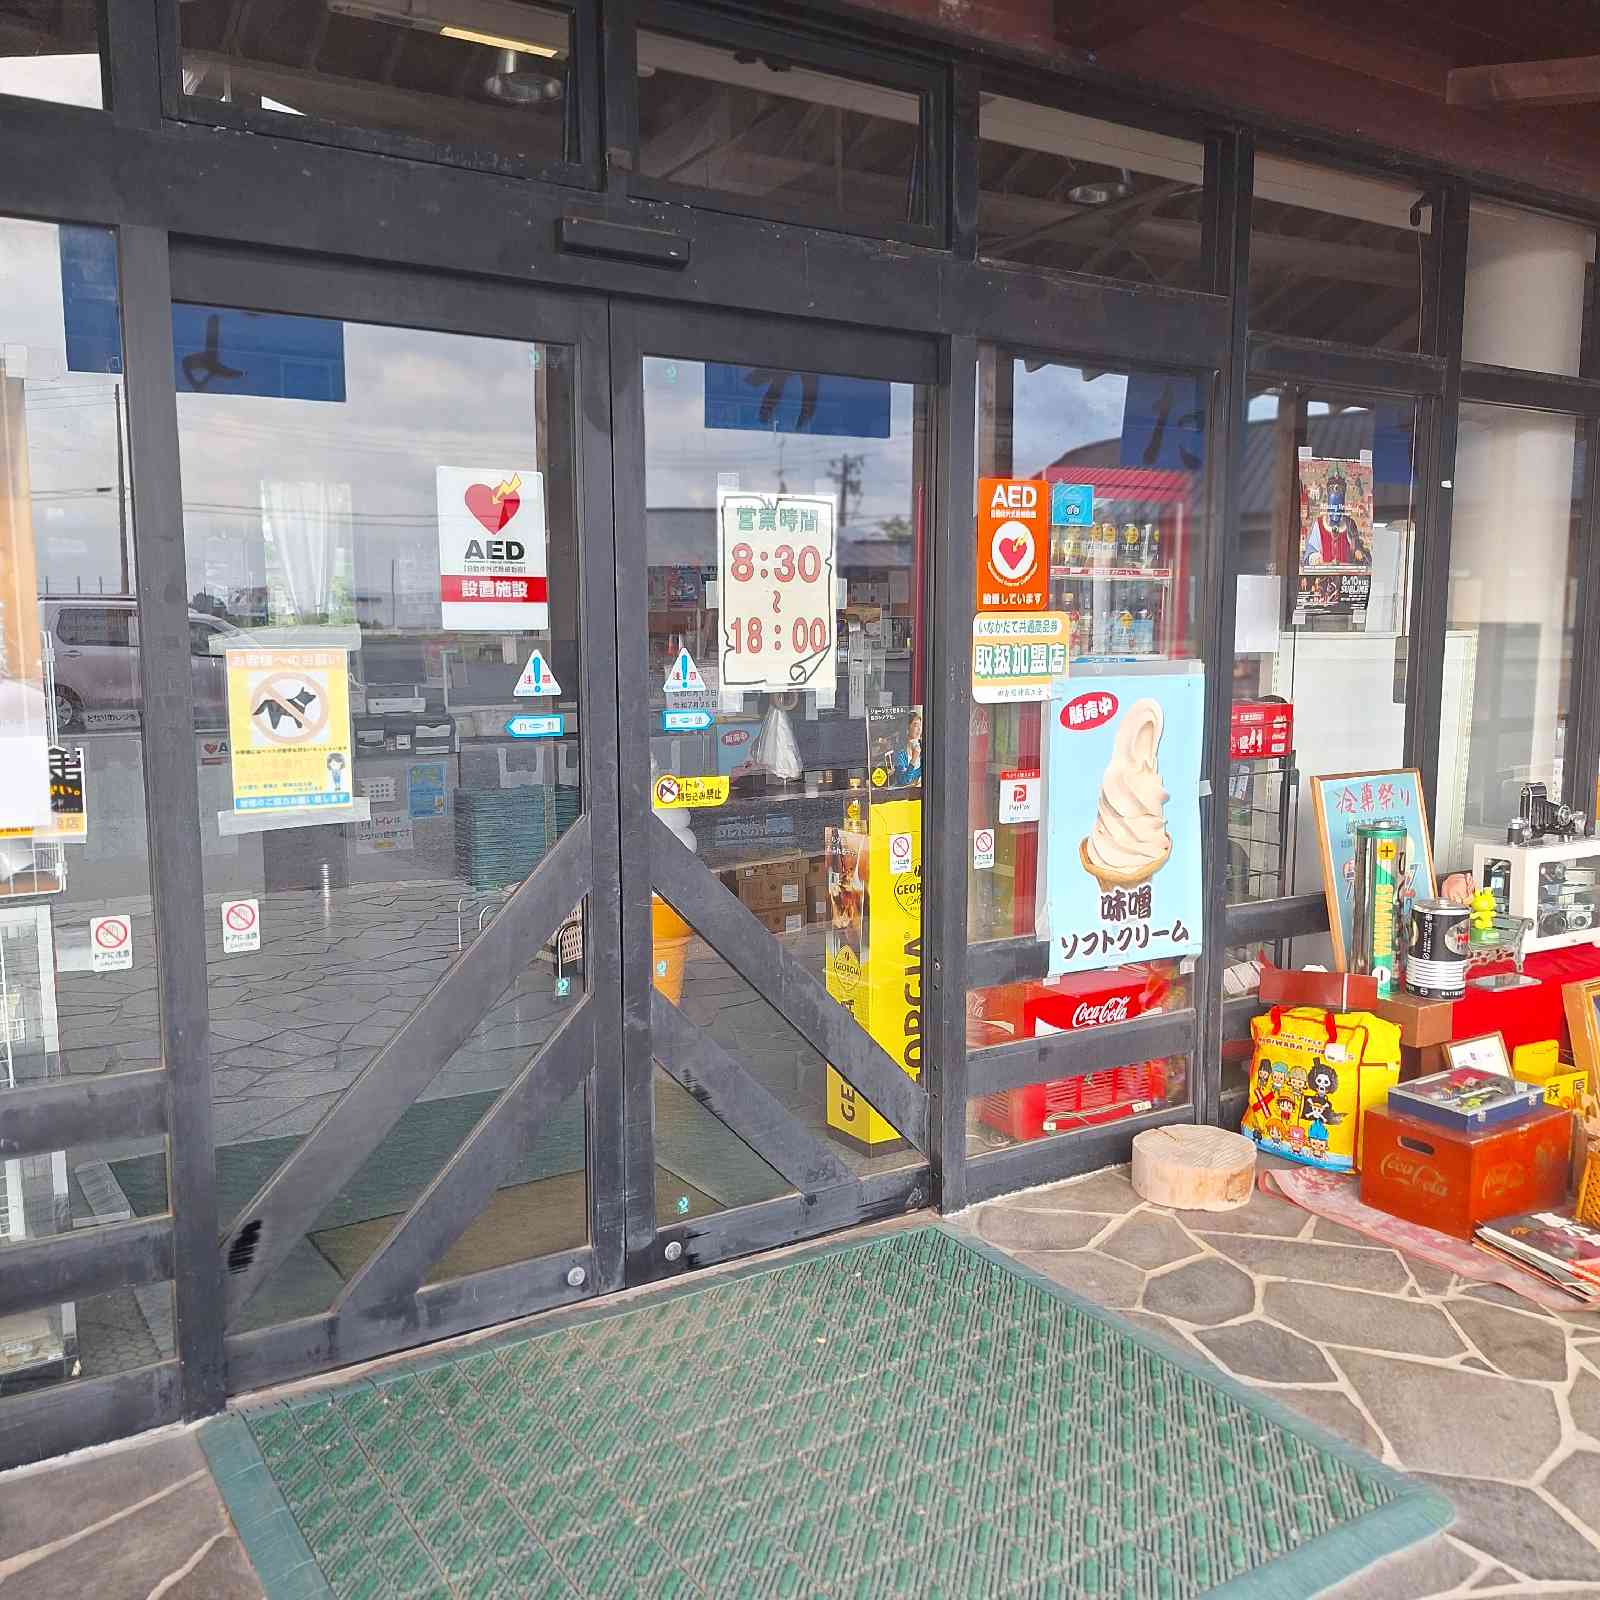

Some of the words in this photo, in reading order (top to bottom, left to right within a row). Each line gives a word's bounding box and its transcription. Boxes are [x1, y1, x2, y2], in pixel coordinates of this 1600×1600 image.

[991, 484, 1037, 508] AED
[737, 507, 819, 533] 営業時間
[464, 539, 525, 560] AED
[731, 542, 821, 583] 8:30
[462, 580, 528, 597] 設置施設
[983, 592, 1042, 605] 設置しています
[731, 617, 827, 654] 18:00
[974, 643, 1065, 674] 取扱加盟店
[1068, 696, 1113, 725] 販売中
[1101, 885, 1152, 922] 味噌
[1061, 920, 1189, 960] ソフトクリーム
[1072, 996, 1131, 1028] Coca-Cola
[1380, 1152, 1449, 1197] Coca-Cola
